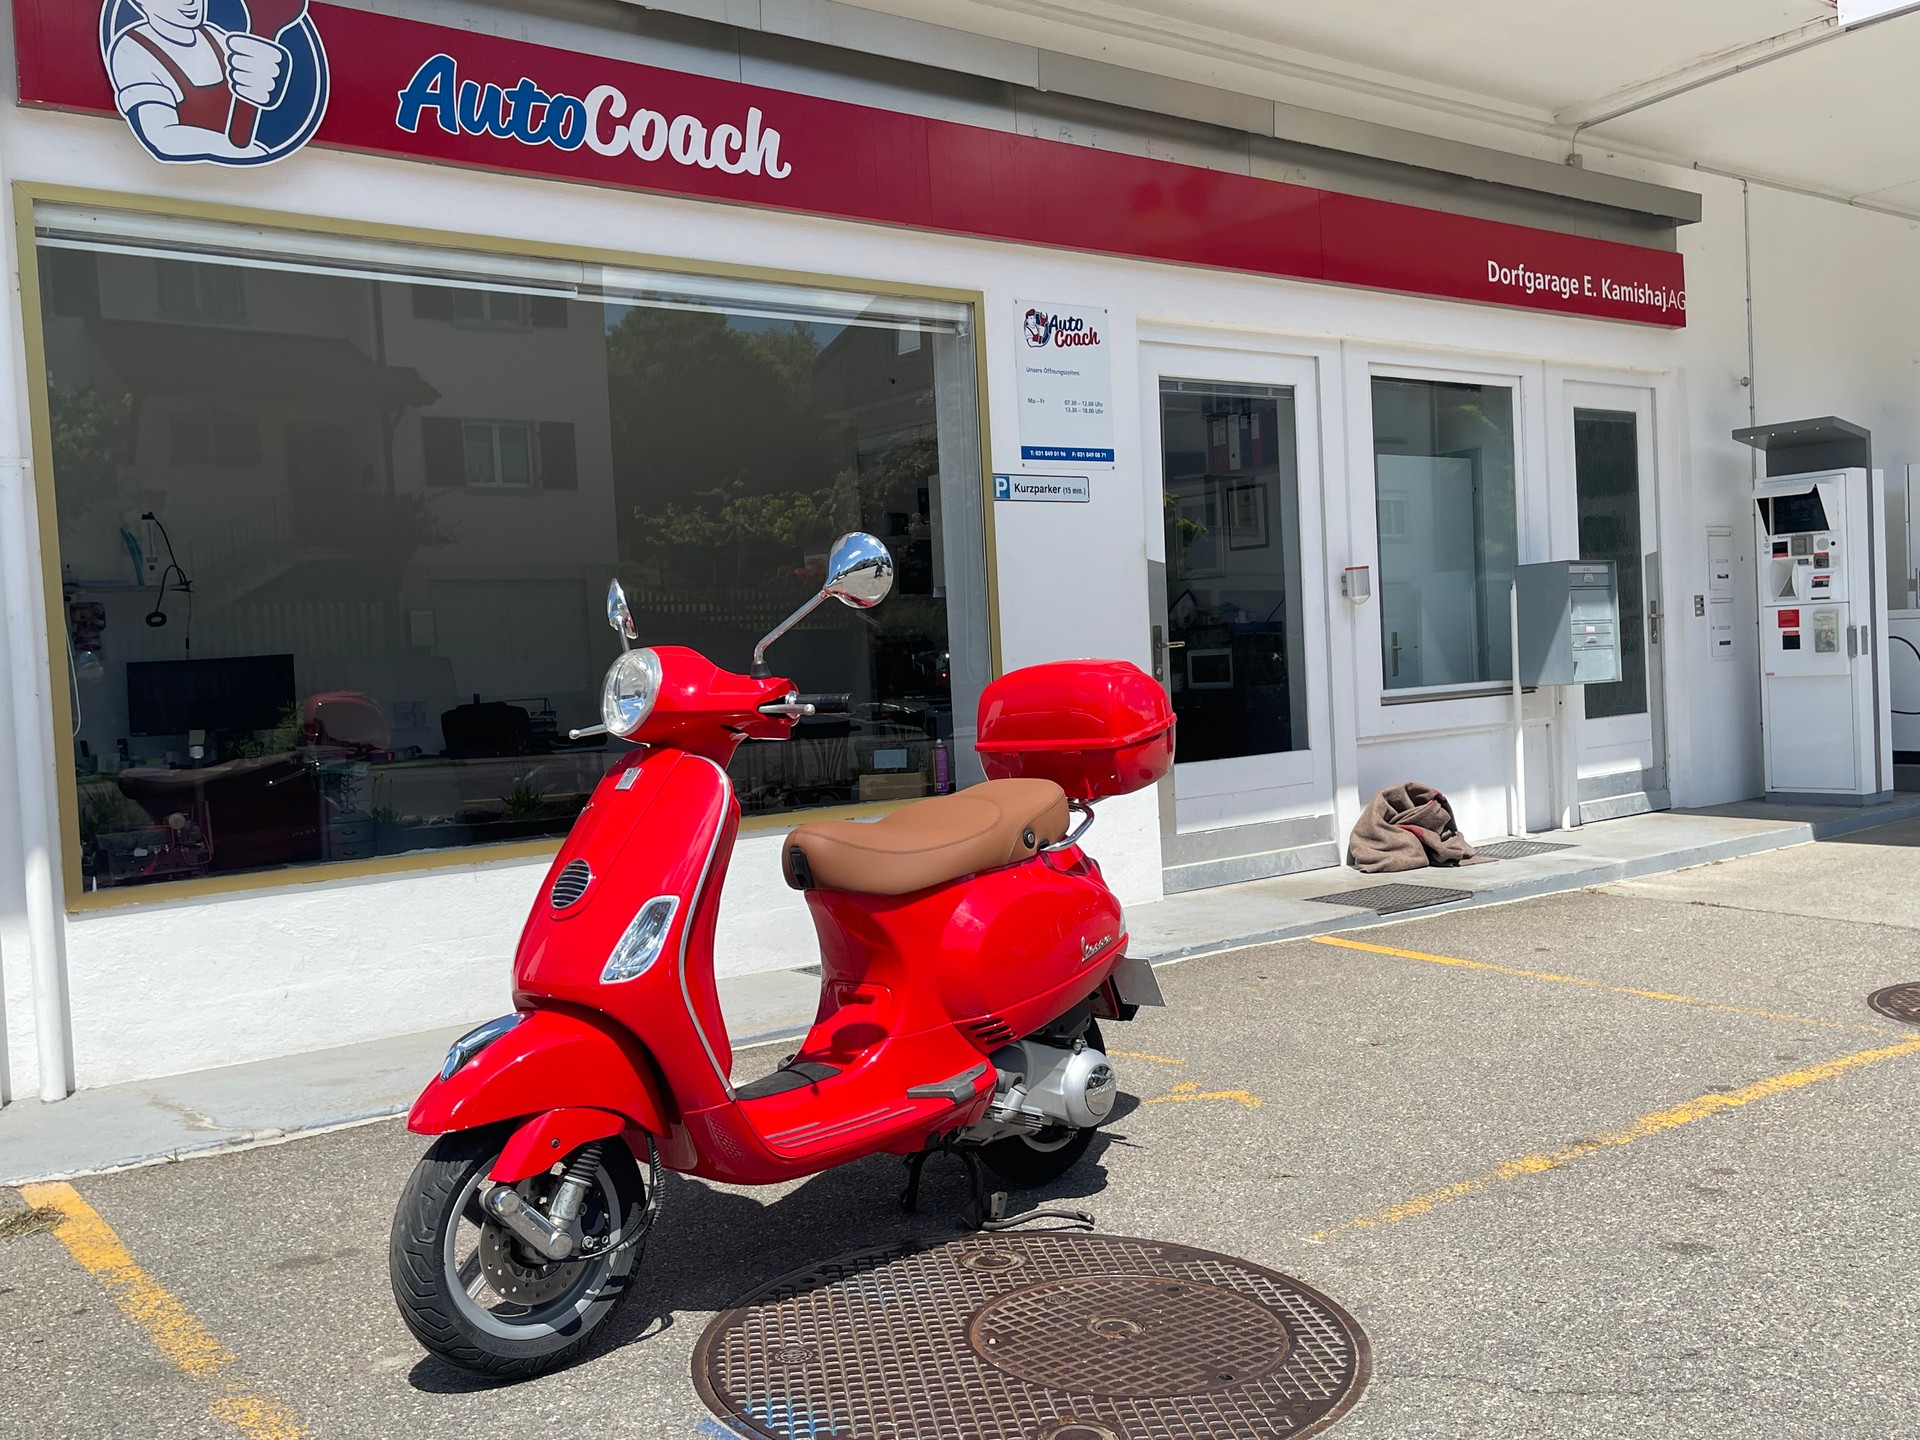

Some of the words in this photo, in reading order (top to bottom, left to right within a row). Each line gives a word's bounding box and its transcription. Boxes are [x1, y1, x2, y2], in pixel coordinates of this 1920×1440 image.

[1487, 260, 1579, 299] Dorfgarage
[1584, 275, 1597, 297] E.
[1601, 278, 1666, 312] Kamishaj
[1048, 314, 1083, 334] Auto
[1054, 327, 1101, 347] Coach
[995, 477, 1008, 498] P
[1014, 483, 1061, 495] Kurzparker
[1063, 486, 1071, 494] (15
